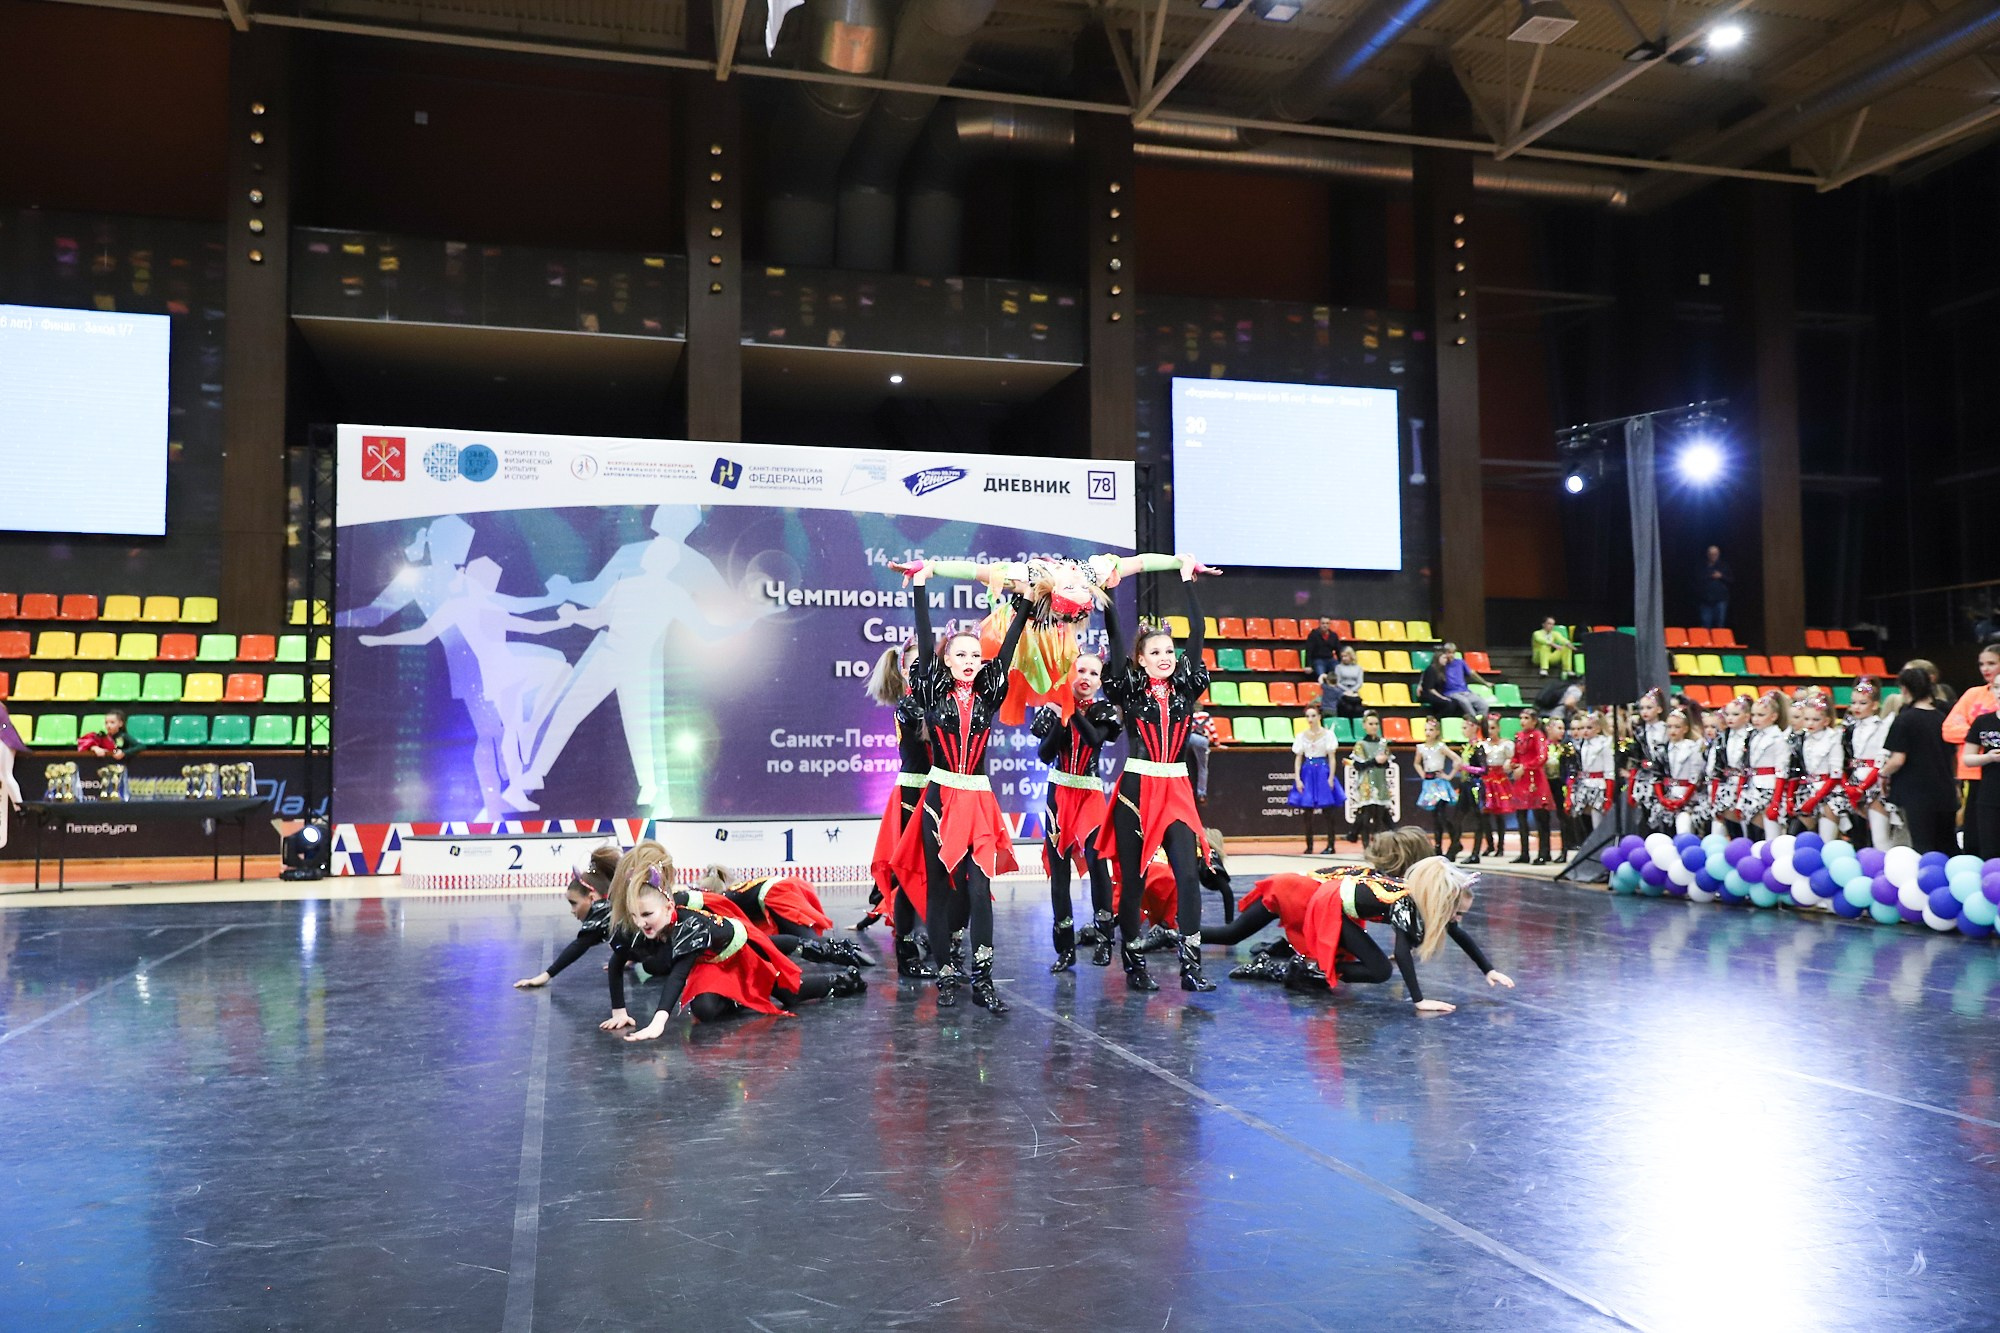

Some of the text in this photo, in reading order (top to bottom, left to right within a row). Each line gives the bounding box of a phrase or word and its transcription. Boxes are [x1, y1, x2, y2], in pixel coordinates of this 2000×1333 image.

[10, 317, 33, 330] лет)
[41, 319, 76, 332] Финал
[84, 321, 116, 335] Заход
[504, 457, 553, 465] ФИЗИЧЕСКОЙ
[504, 465, 537, 473] КУЛЬТУРЕ
[748, 473, 823, 485] ФЕДЕРАЦИЯ
[983, 477, 1071, 494] ДНЕВНИК
[1093, 477, 1111, 494] 78
[865, 547, 887, 567] 14
[928, 589, 946, 609] и
[835, 660, 871, 678] по
[766, 759, 794, 773] по
[1002, 781, 1015, 796] и
[66, 822, 138, 835] Петербурга
[781, 828, 797, 862] 1
[508, 844, 523, 870] 2
